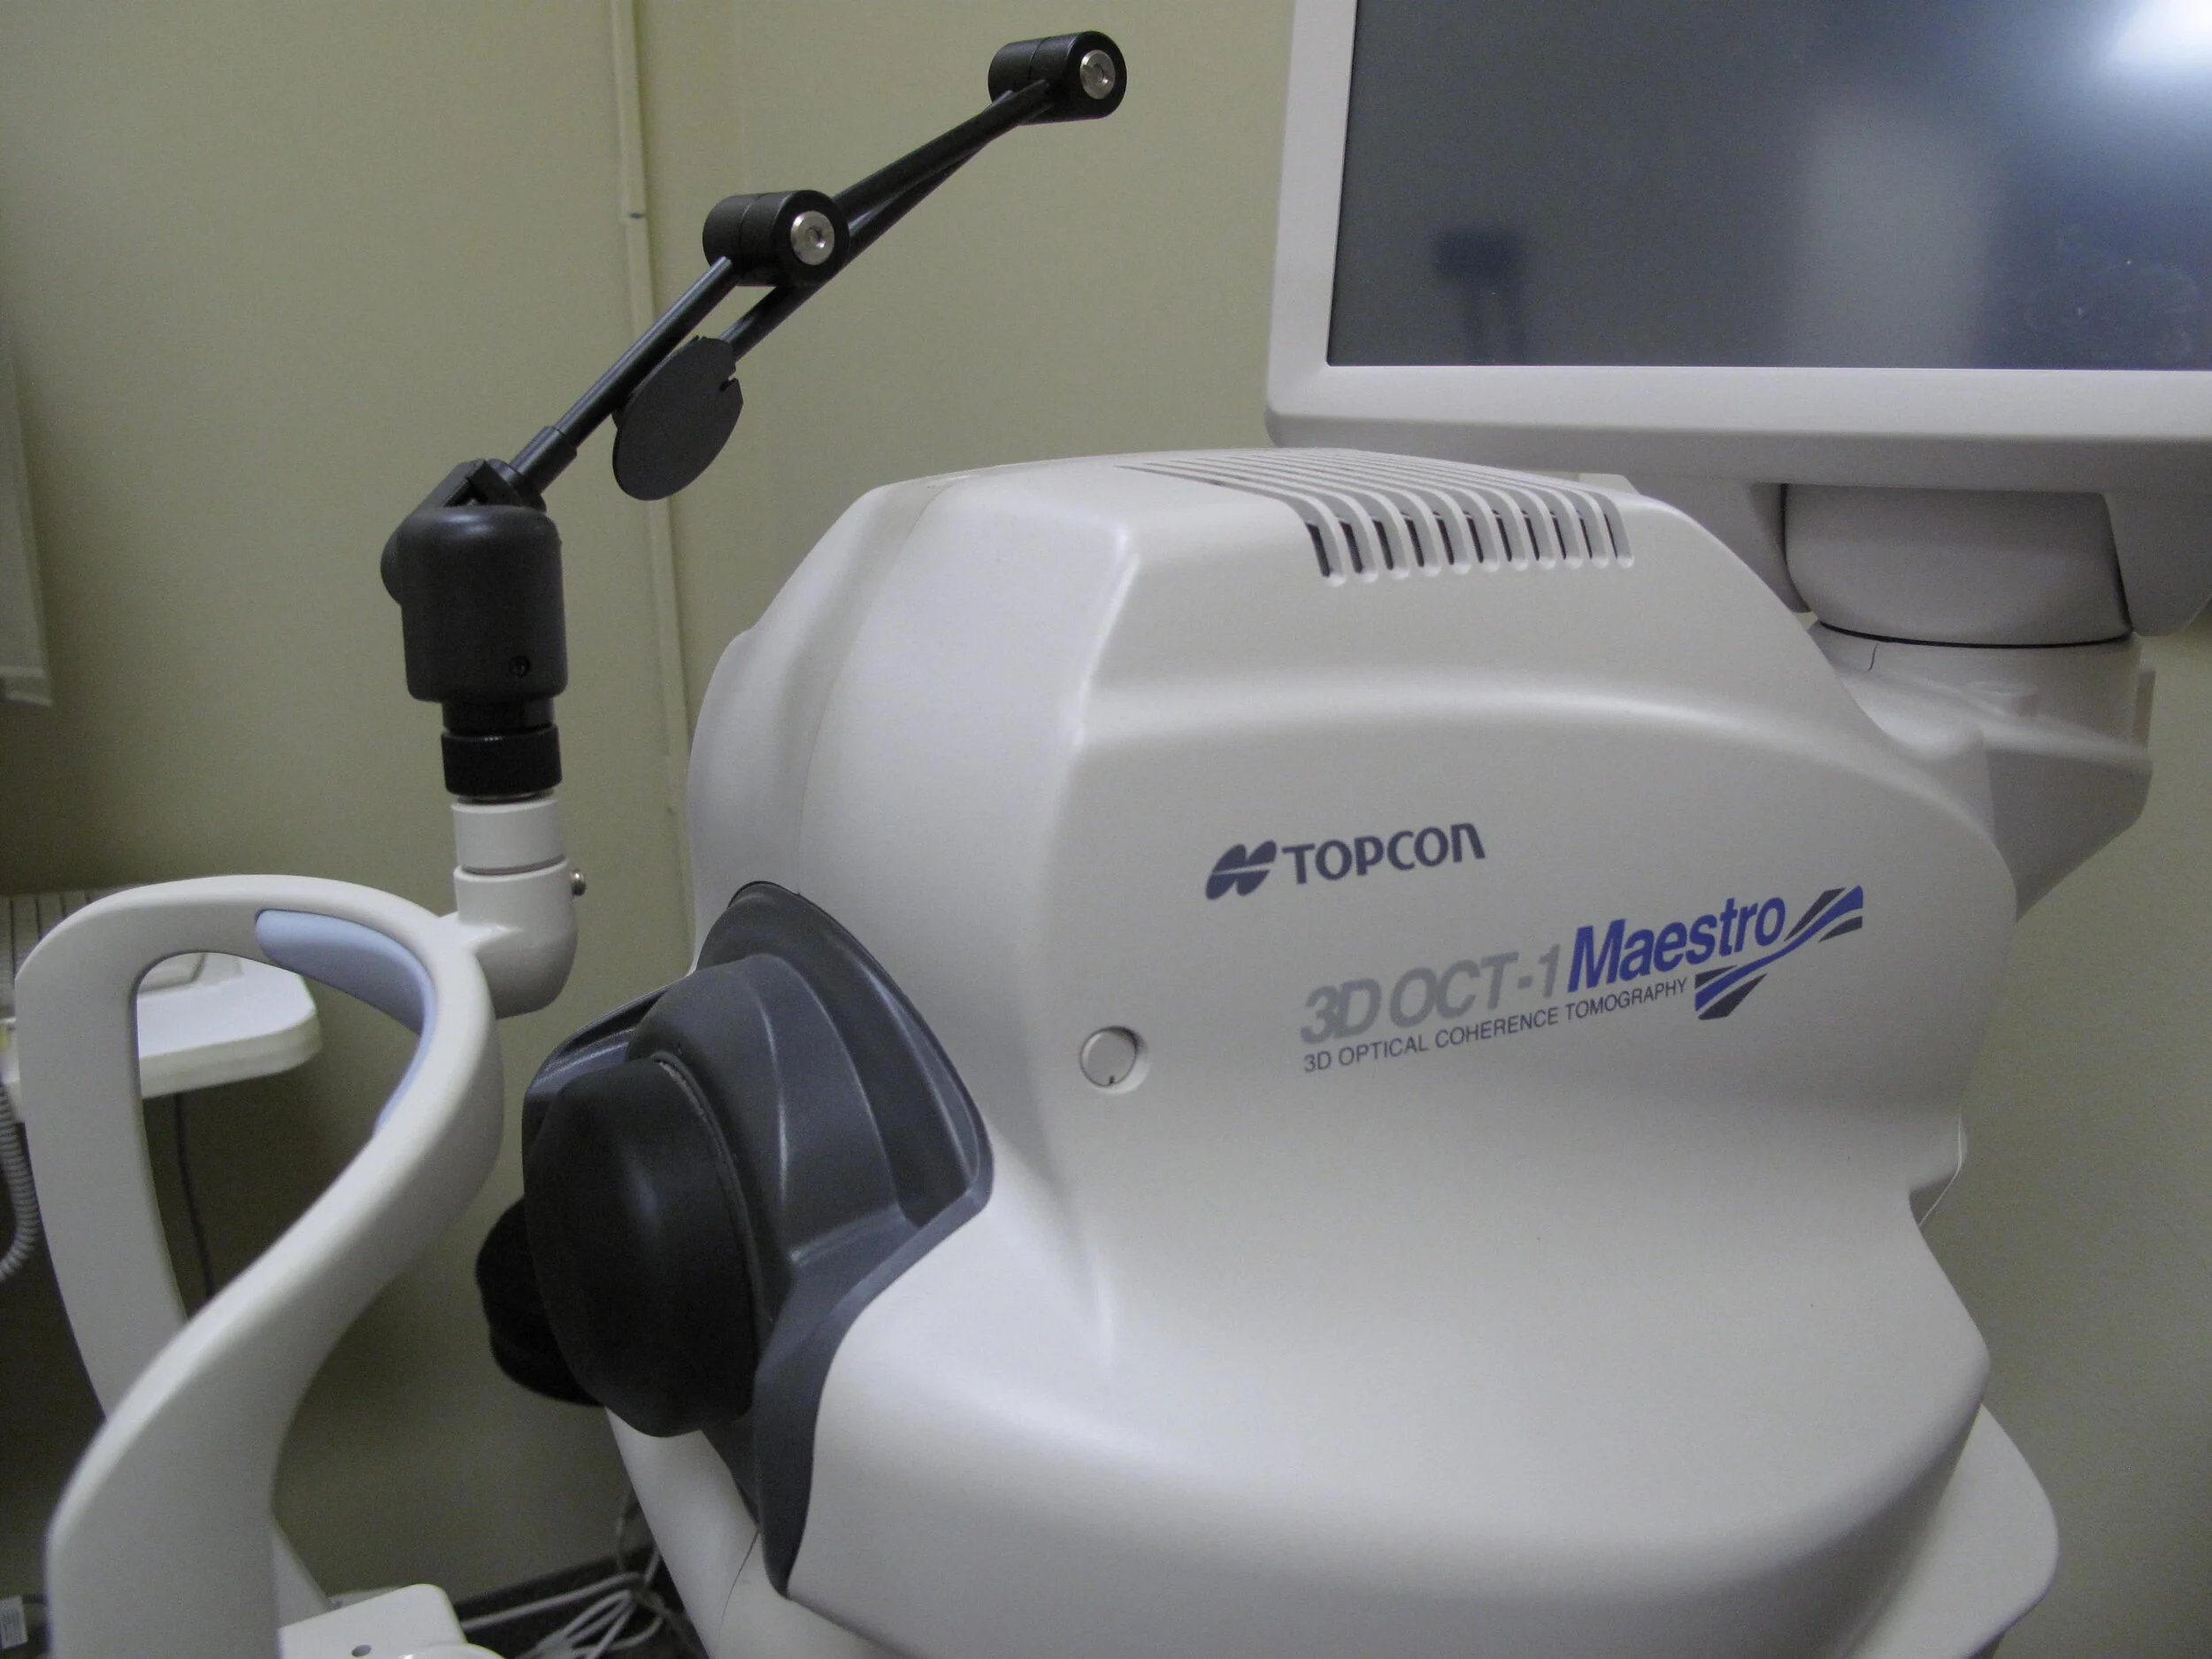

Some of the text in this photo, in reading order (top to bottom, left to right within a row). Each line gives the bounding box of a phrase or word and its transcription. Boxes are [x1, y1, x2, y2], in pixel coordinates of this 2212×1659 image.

[1282, 822, 1486, 885] TOPCON
[1300, 896, 1786, 1045] 3D OCT-1 Maestro
[1303, 978, 1689, 1073] 3D OPTICAL COHERENCE TOMOGRAPHY
